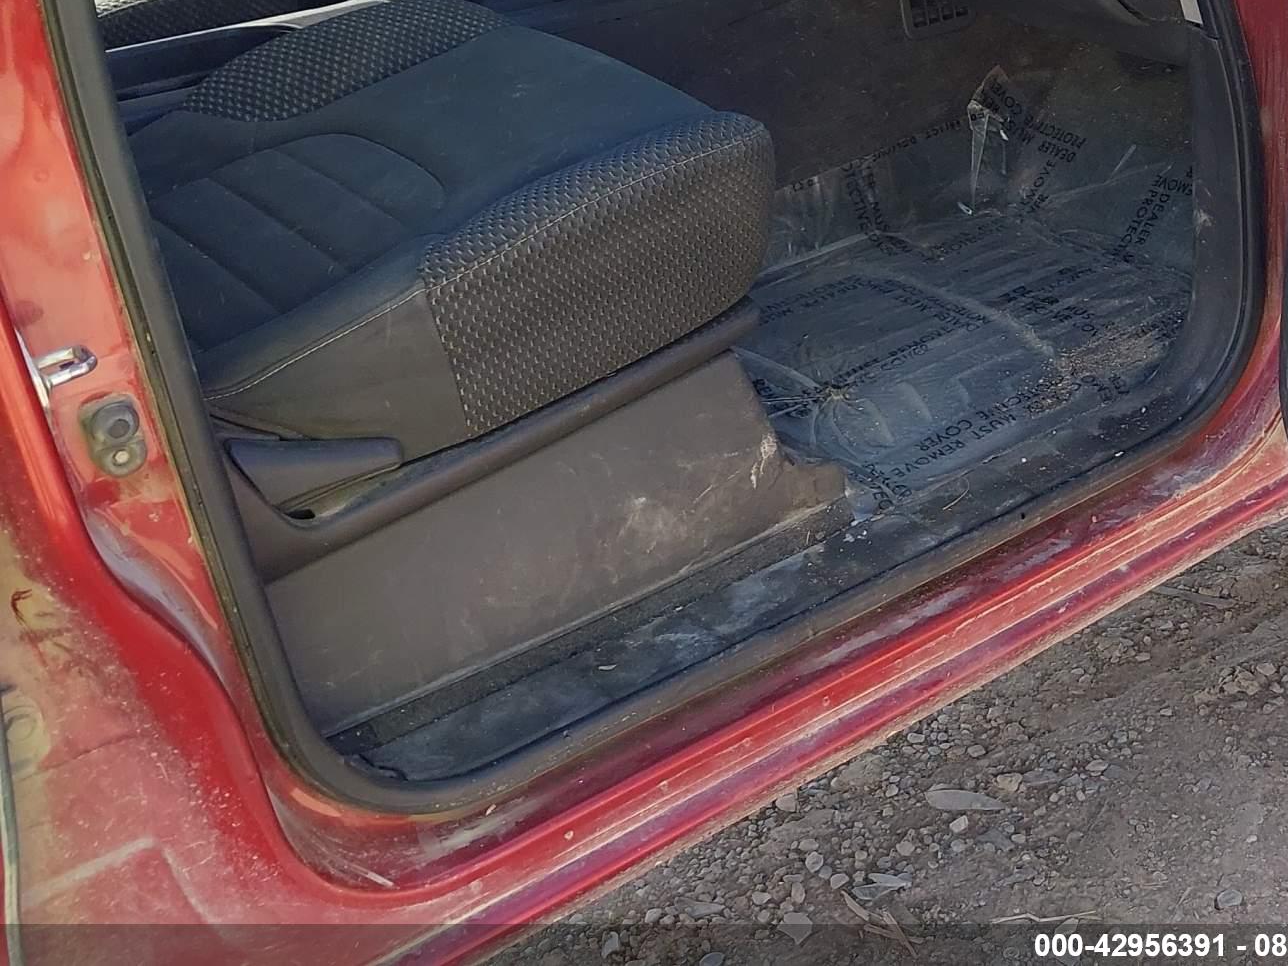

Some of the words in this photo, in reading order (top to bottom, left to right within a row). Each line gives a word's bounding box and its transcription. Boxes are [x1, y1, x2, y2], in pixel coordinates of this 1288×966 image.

[1135, 191, 1170, 247] DEALER
[914, 419, 972, 453] COVER
[891, 439, 964, 478] REMOVE
